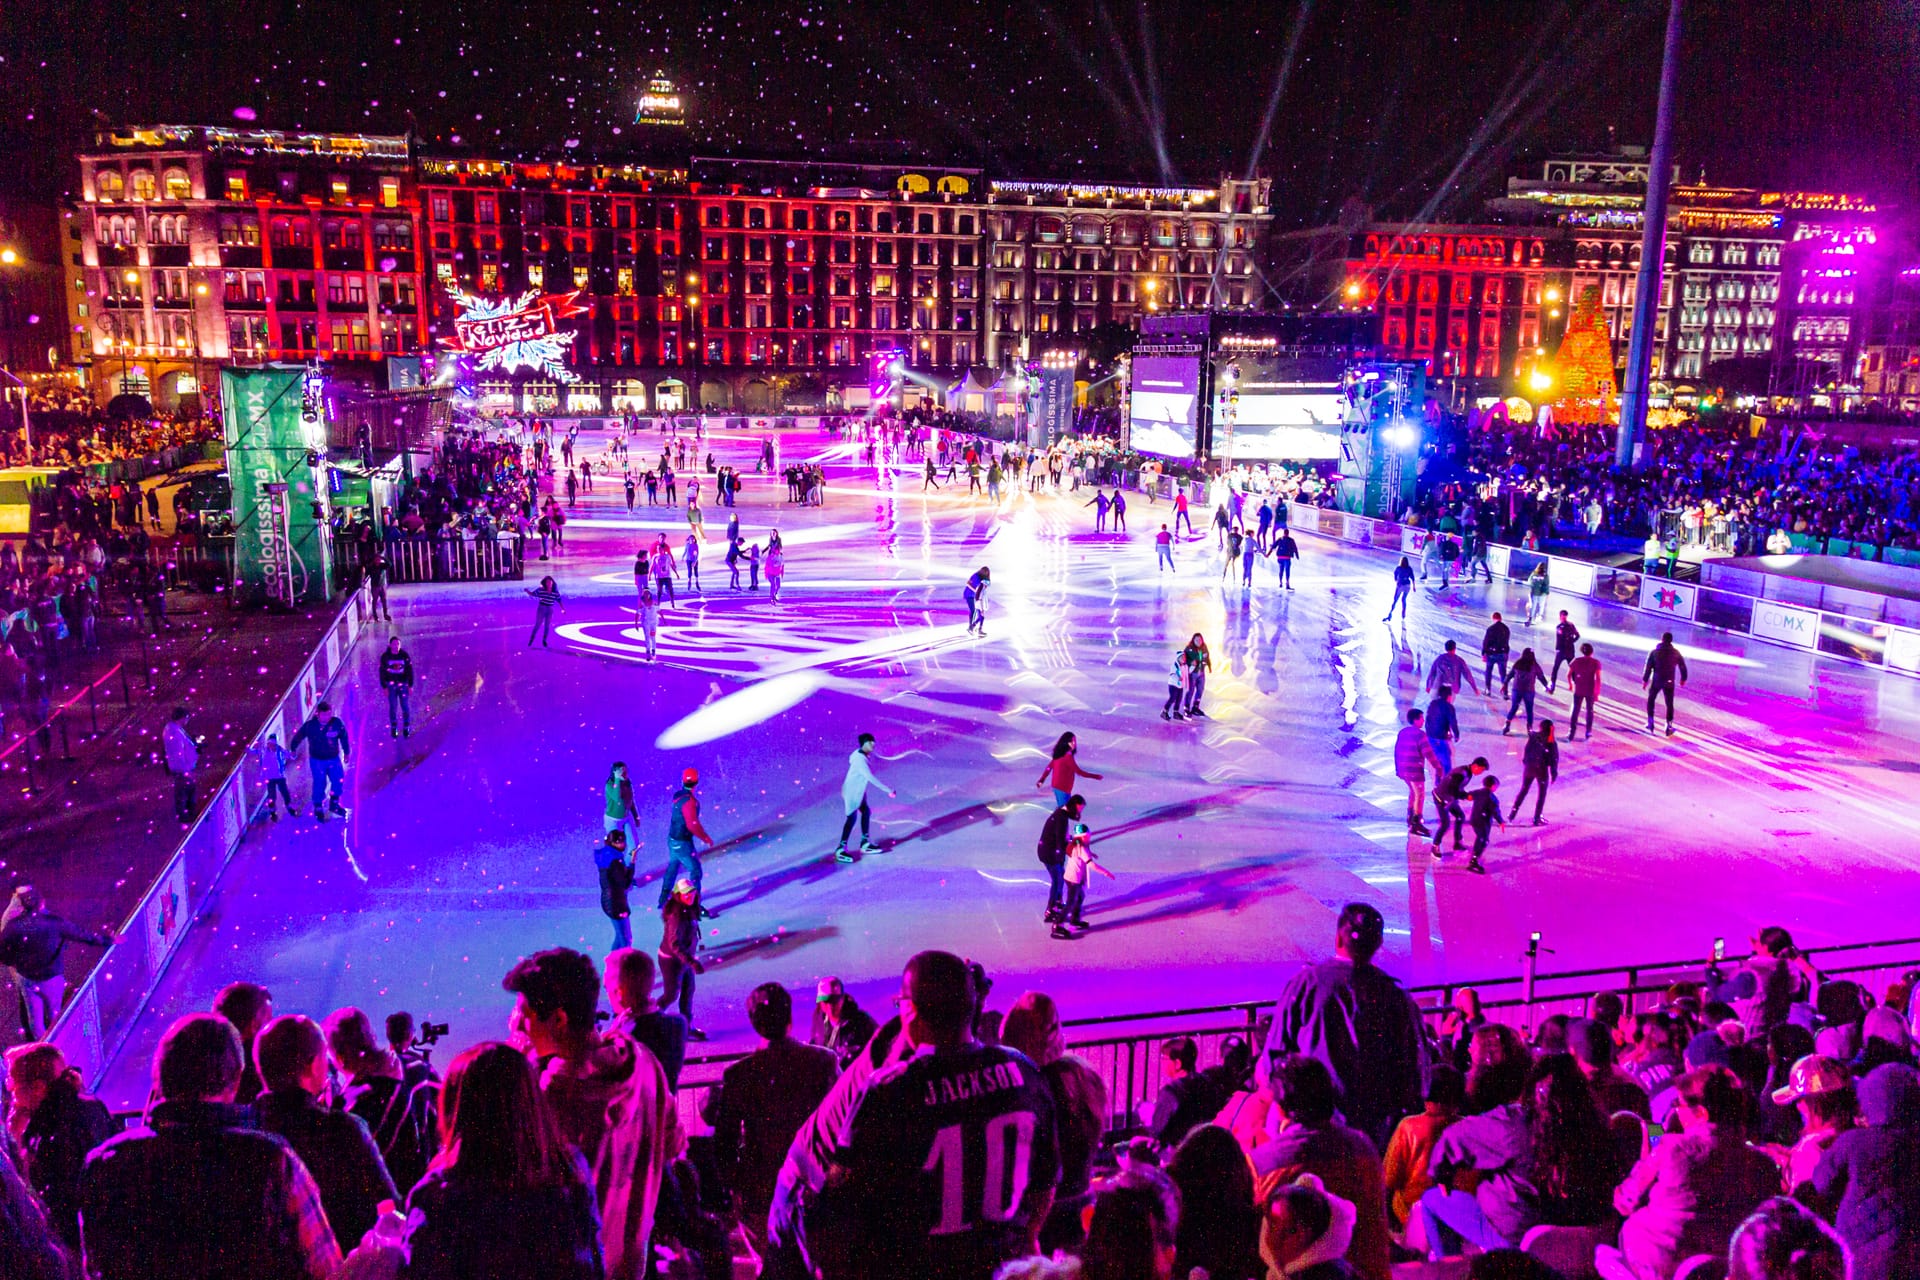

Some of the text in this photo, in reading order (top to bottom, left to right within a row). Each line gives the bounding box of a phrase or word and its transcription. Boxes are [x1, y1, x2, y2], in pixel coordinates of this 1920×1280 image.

[467, 322, 545, 348] Navidad
[1764, 612, 1806, 632] CDMX
[925, 1061, 1024, 1105] JACKSON
[923, 1111, 1037, 1235] 10
